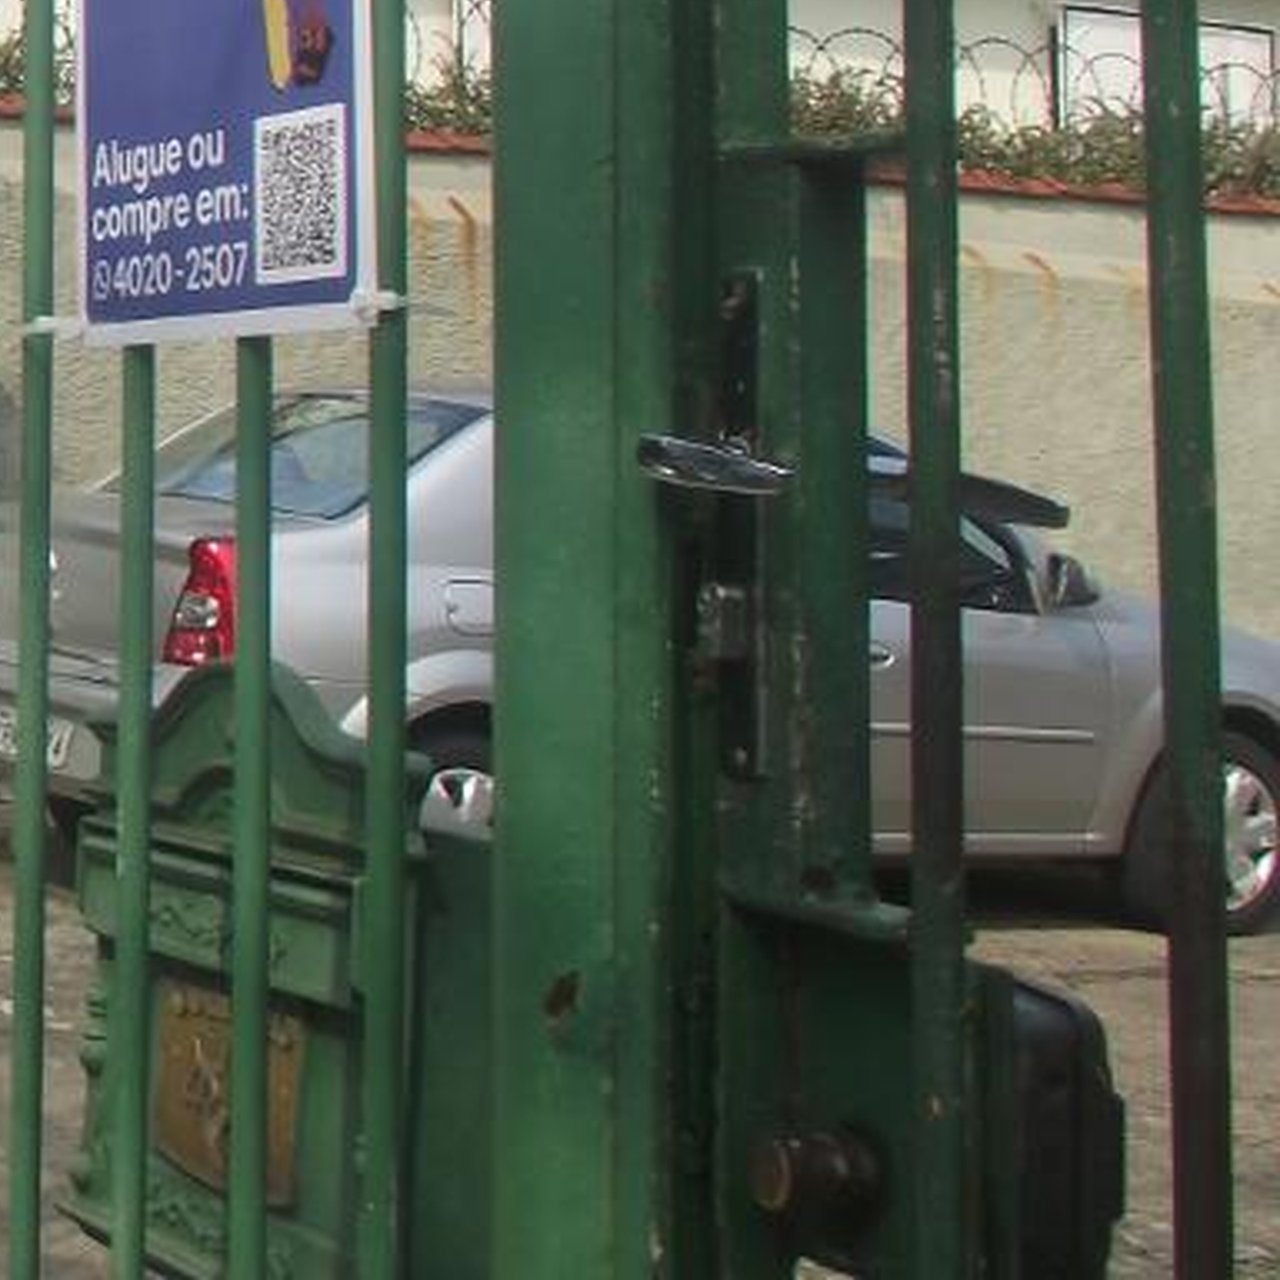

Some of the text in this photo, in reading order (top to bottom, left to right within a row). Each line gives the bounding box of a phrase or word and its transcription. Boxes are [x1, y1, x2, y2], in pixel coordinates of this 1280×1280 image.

[92, 129, 225, 194] Alugue ou
[92, 183, 250, 246] compre em:
[113, 242, 248, 298] 4020-2507
